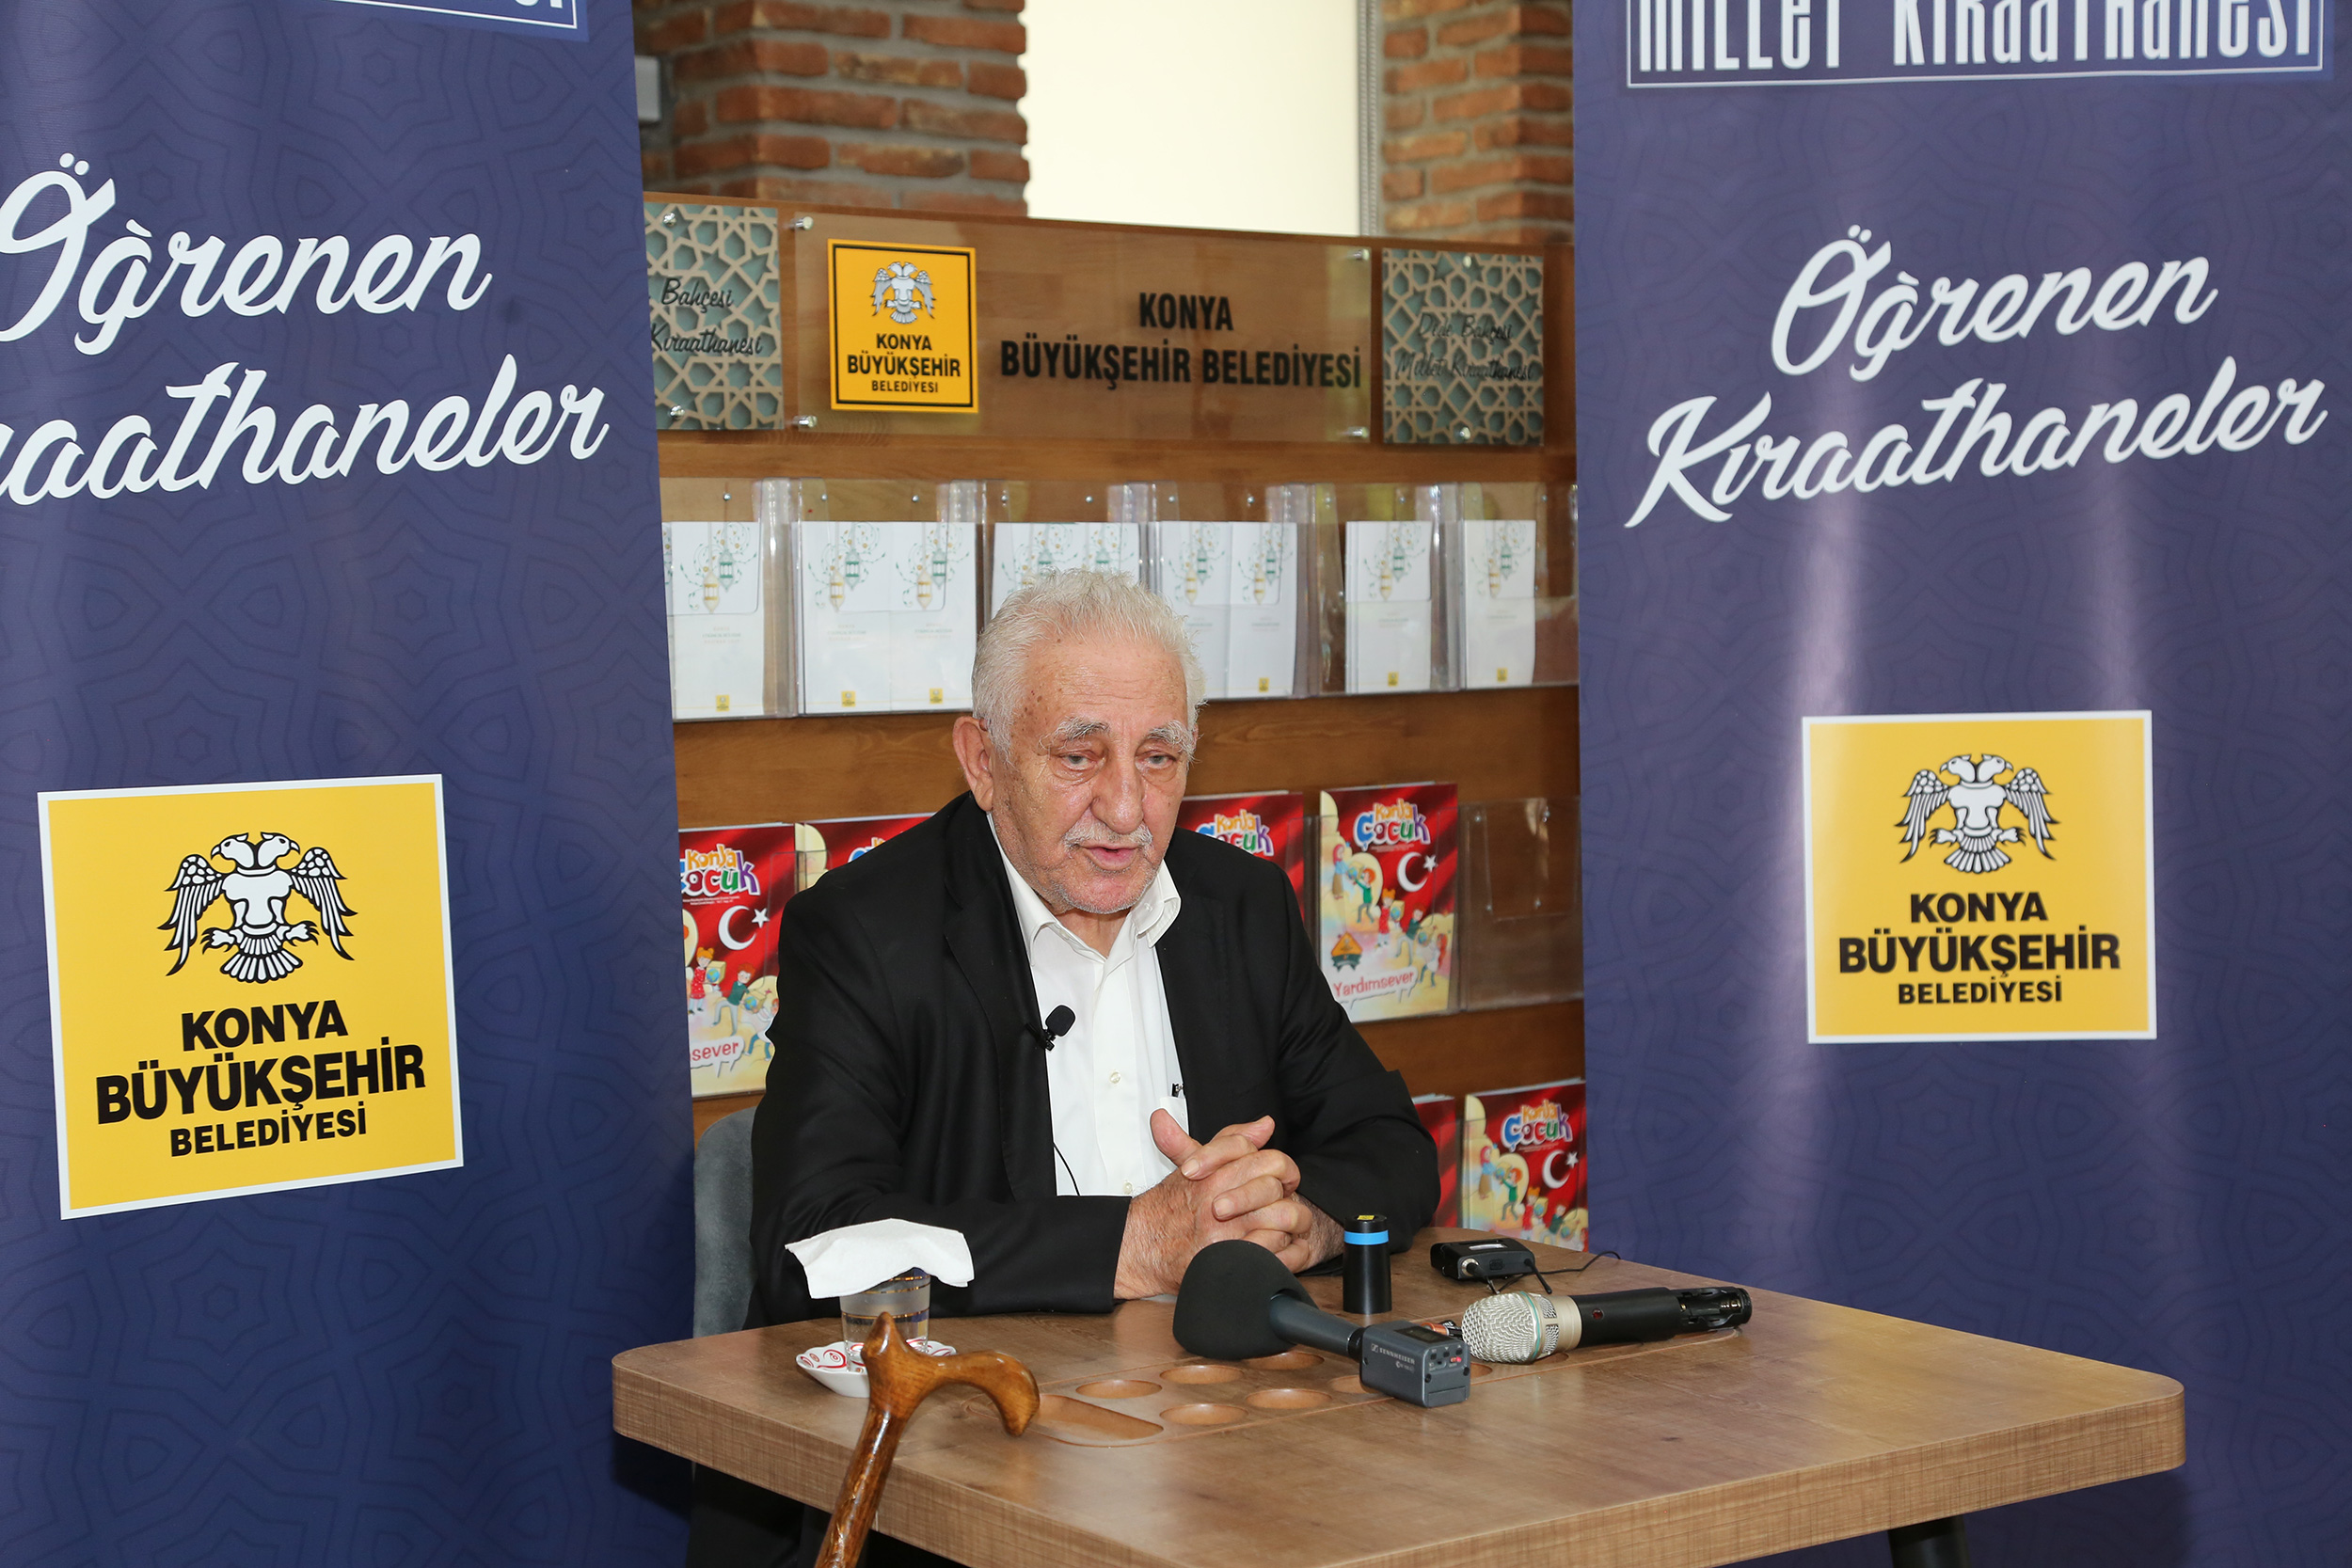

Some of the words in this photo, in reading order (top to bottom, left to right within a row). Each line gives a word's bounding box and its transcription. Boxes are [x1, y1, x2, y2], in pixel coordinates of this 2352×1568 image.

[660, 277, 734, 313] Bahçesi
[1138, 292, 1234, 331] KONYA
[876, 333, 932, 351] KONYA
[999, 332, 1192, 390] BÜYÜKŞEHİR
[1201, 343, 1360, 388] BELEDİYESİ
[847, 350, 961, 378] BÜYÜKŞEHİR
[1624, 356, 2328, 529] Kıraathaneler
[680, 850, 760, 896] ocuk
[1910, 892, 2048, 924] KONYA
[1839, 925, 2121, 977] BÜYÜKŞEHİR
[1333, 972, 1414, 997] Yardımsever
[1898, 975, 2062, 1005] BELEDİYESİ
[181, 999, 348, 1052] KONYA
[691, 1041, 739, 1062] sever
[96, 1036, 426, 1125] BÜYÜKŞEHİR
[170, 1101, 367, 1157] BELEDİYESİ
